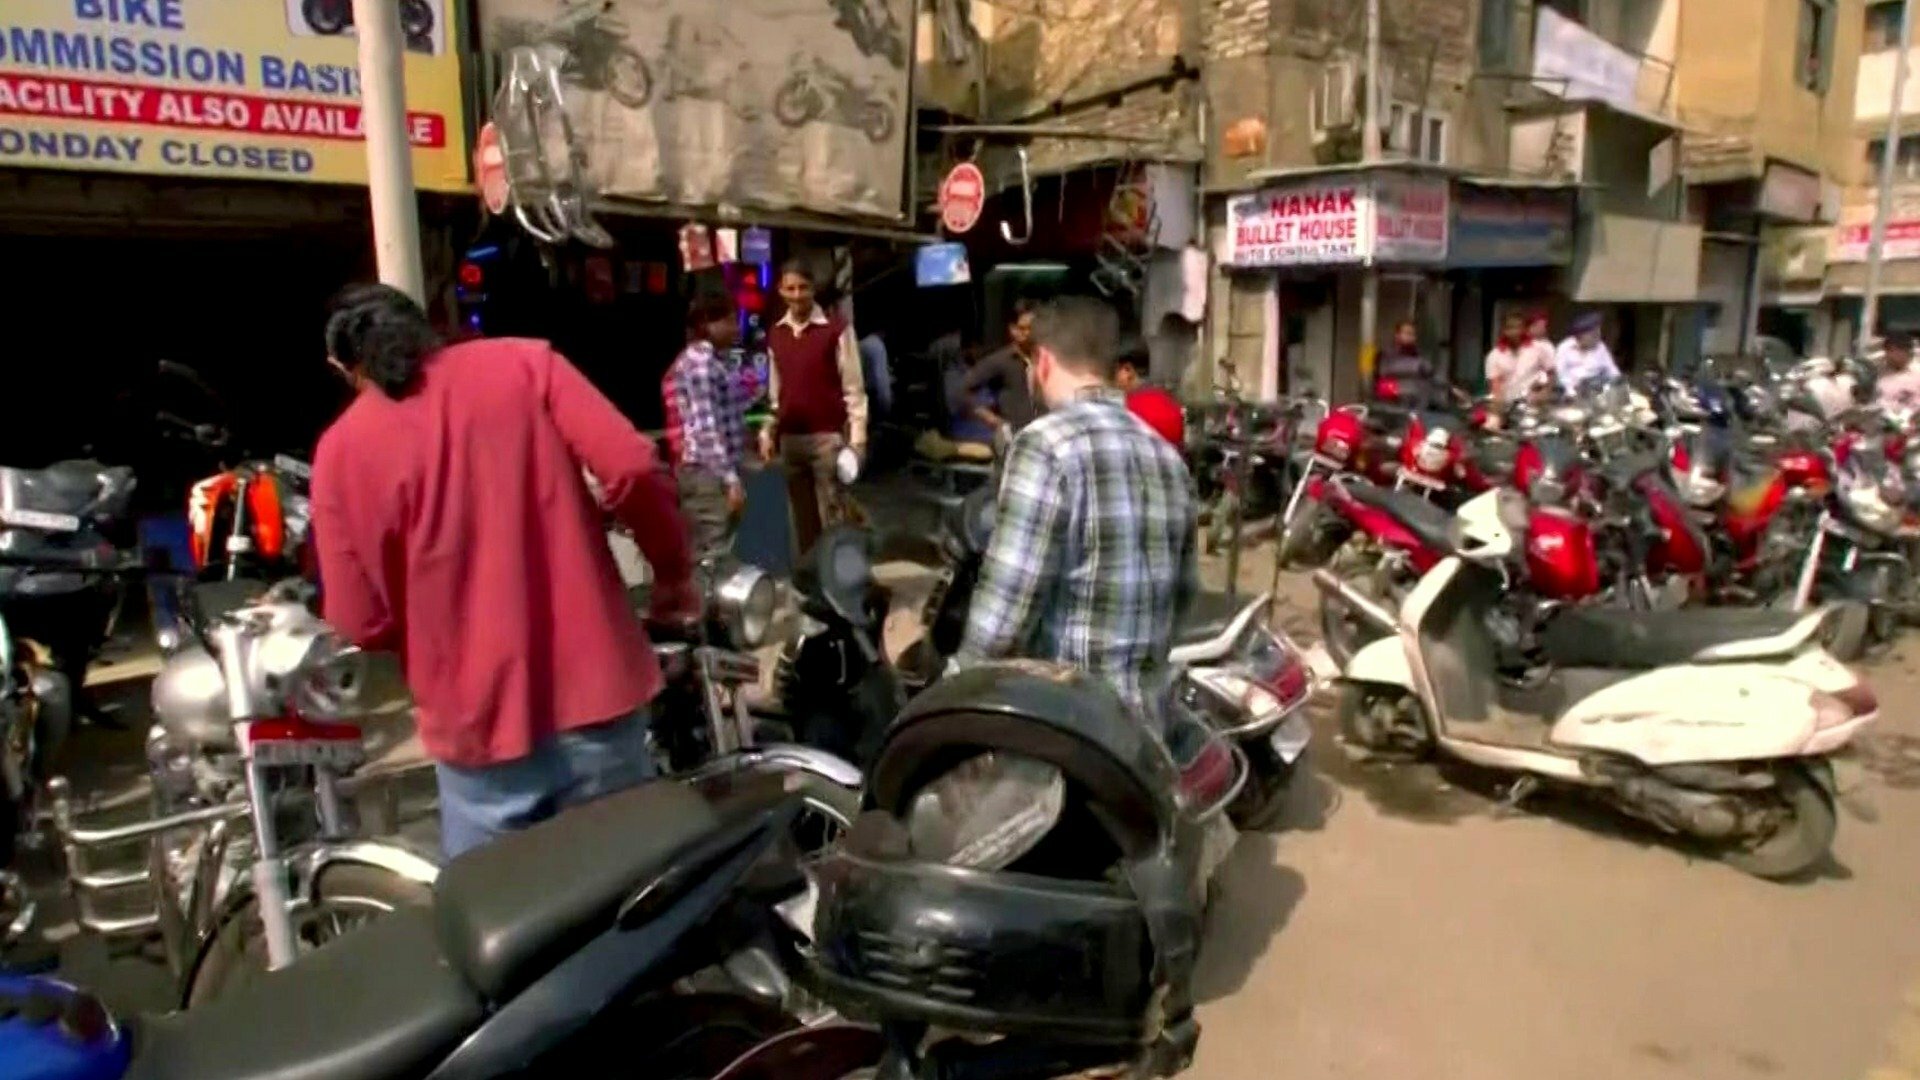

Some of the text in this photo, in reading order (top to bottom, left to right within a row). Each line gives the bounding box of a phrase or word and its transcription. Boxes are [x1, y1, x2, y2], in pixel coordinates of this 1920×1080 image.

[75, 0, 184, 30] BIKE
[0, 27, 362, 95] MMISSION BASI
[156, 92, 249, 128] ALSO
[261, 102, 433, 144] AVAILE
[160, 140, 314, 173] CLOSED
[1271, 189, 1356, 217] NANAK
[1236, 222, 1293, 245] BULLET
[1299, 218, 1356, 240] HOUSE
